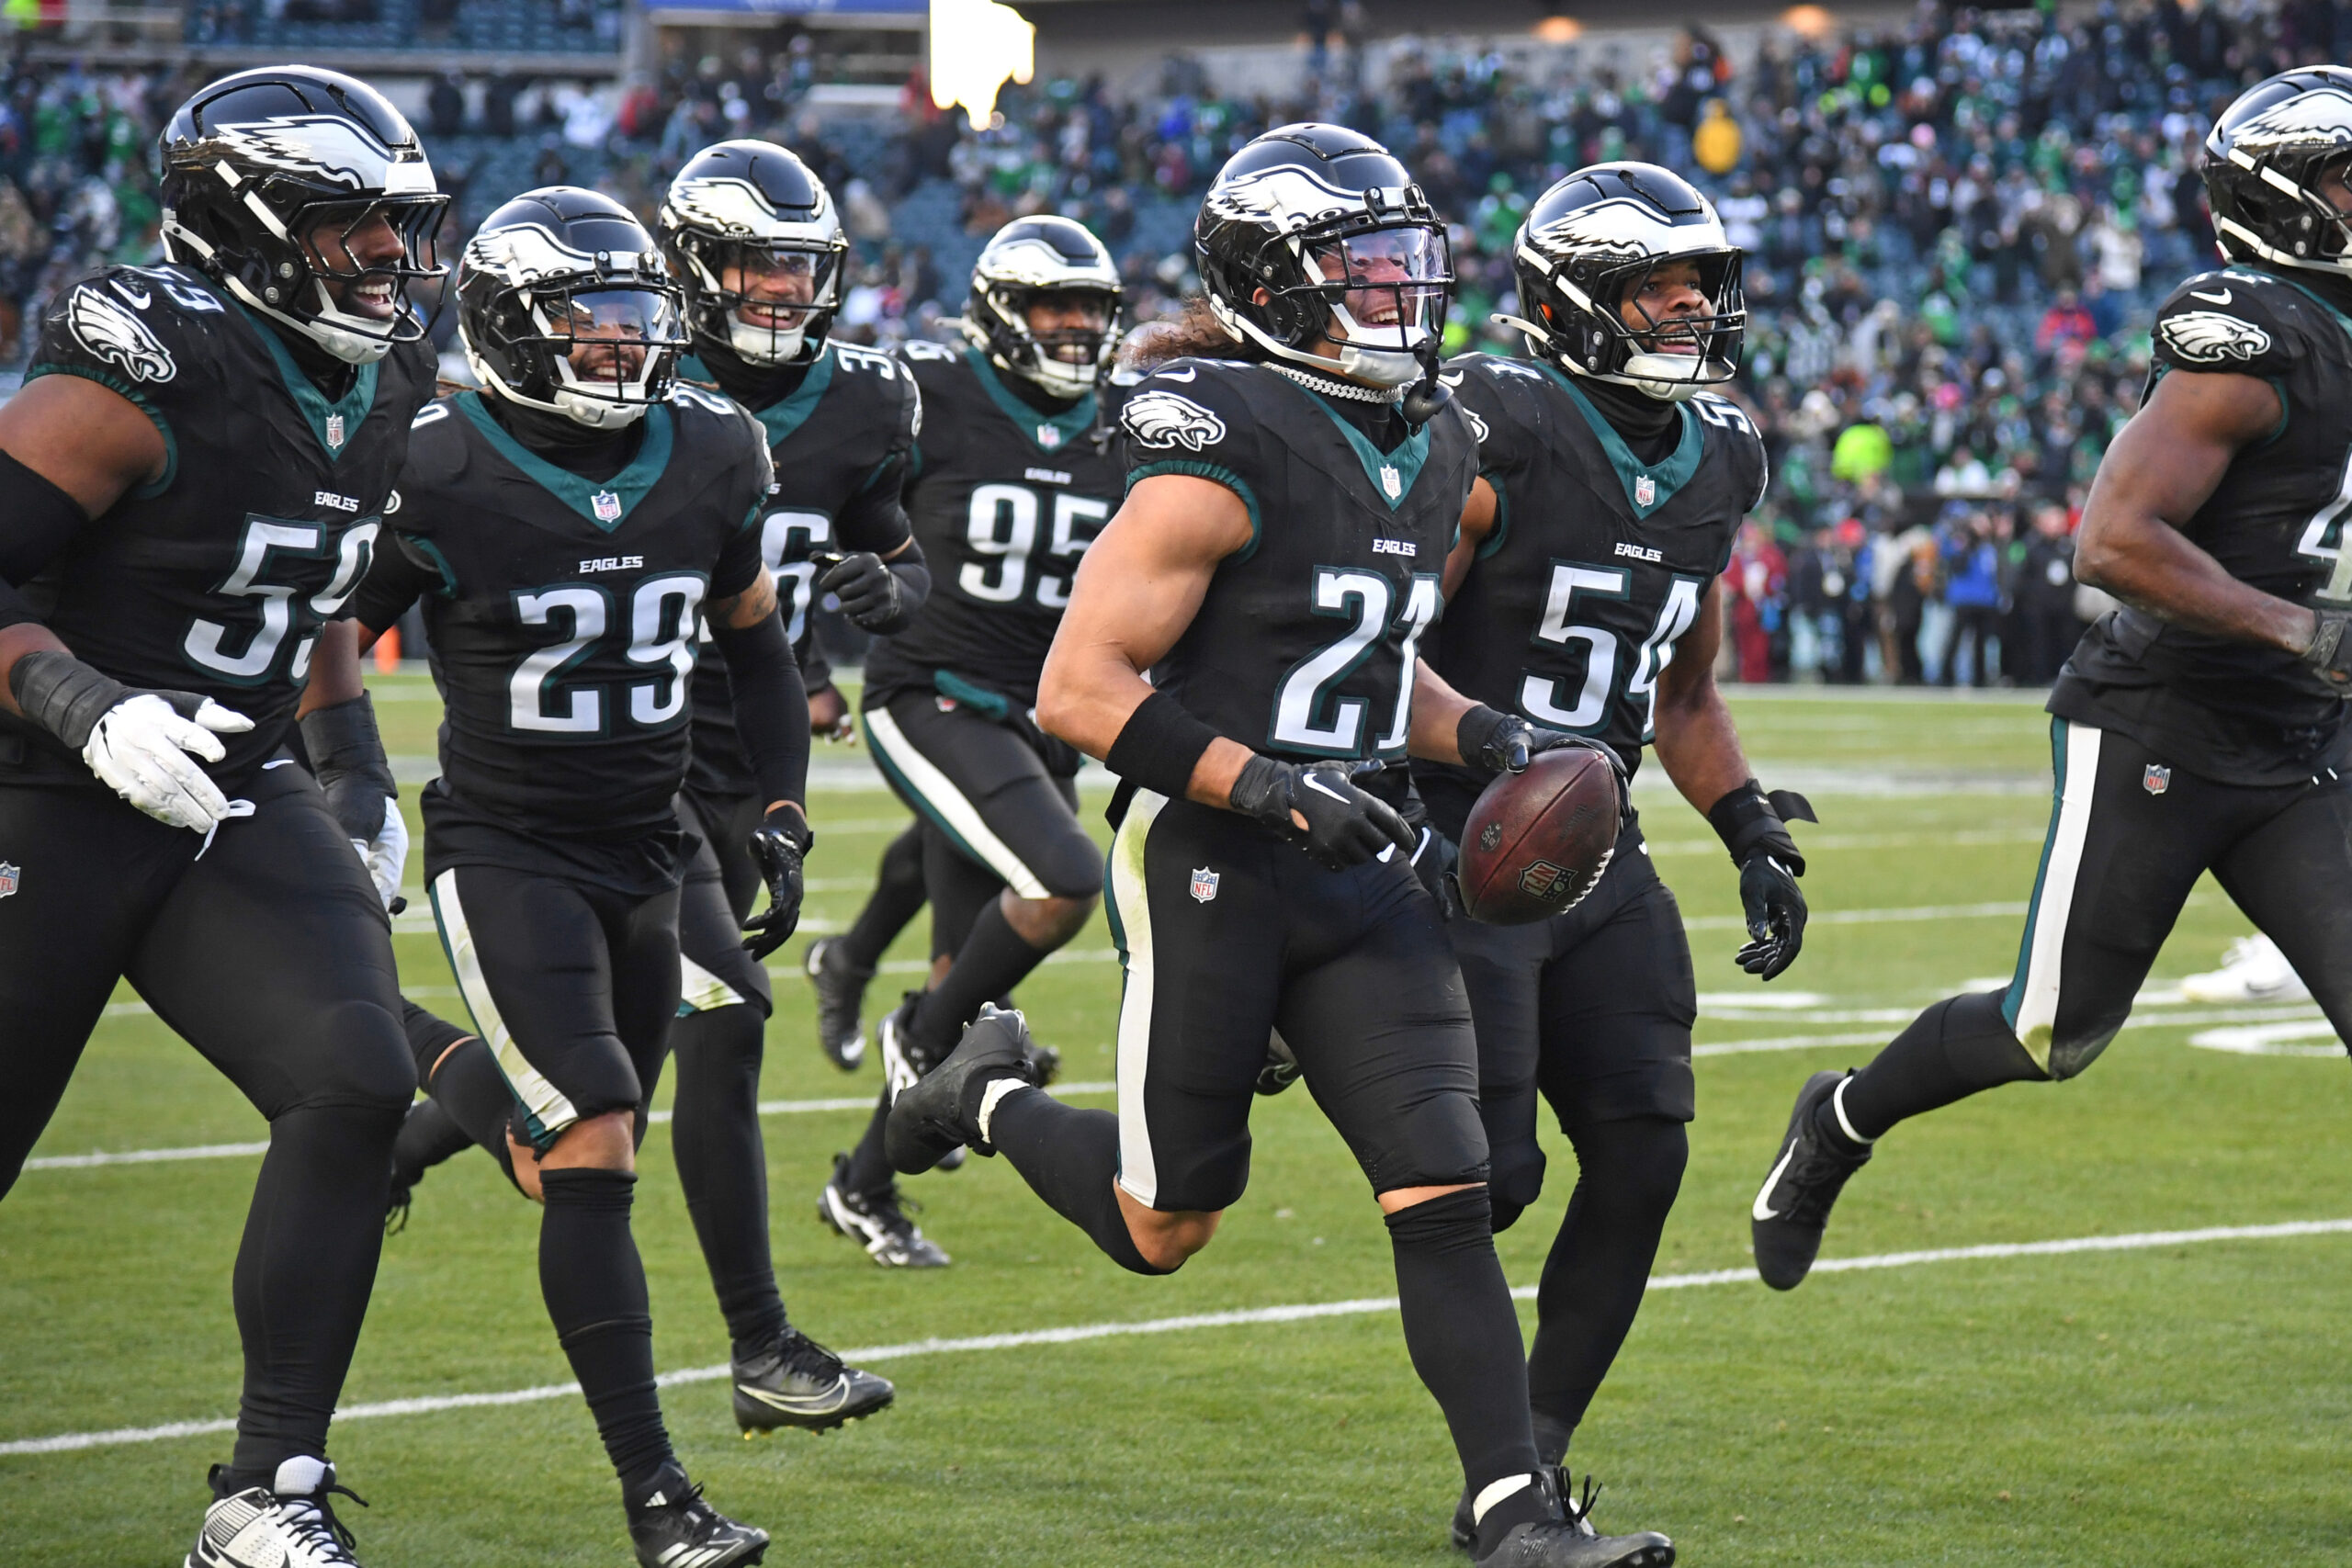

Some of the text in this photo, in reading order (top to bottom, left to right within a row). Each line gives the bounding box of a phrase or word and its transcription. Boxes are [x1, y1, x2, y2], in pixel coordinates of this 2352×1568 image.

[314, 491, 359, 512] EAGLES
[579, 555, 643, 574] EAGLES
[959, 483, 1109, 608] 95
[1372, 538, 1417, 557] EAGLES
[1614, 542, 1663, 563] EAGLES
[184, 519, 380, 680] 59
[509, 576, 706, 733] 29
[1273, 571, 1438, 750] 21
[1521, 564, 1699, 735] 54
[1523, 863, 1559, 892] NFL
